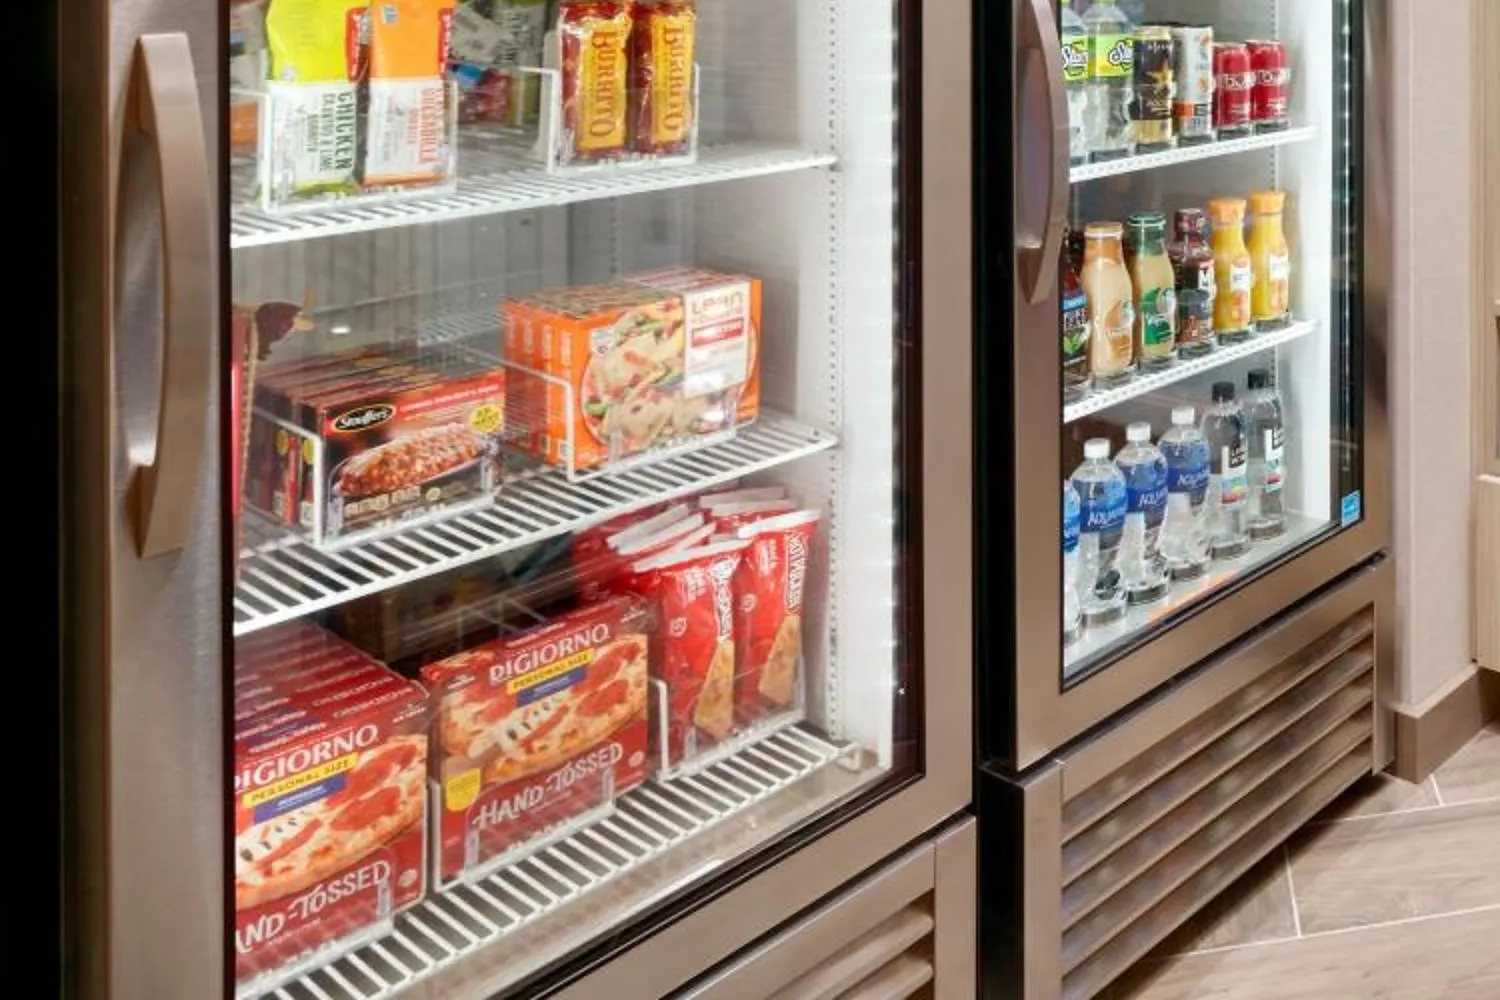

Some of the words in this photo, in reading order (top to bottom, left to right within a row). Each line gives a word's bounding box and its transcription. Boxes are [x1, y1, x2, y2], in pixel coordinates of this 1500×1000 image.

[592, 28, 618, 137] BURRITO
[664, 24, 685, 131] BURRITO
[336, 91, 355, 170] CHICKEN
[489, 623, 610, 685] DIGIORNO
[251, 772, 319, 801] PERSONAL
[322, 757, 350, 776] SIZE
[472, 742, 624, 829] HAND-TOSSED
[235, 859, 391, 954] ND-TOSSED
